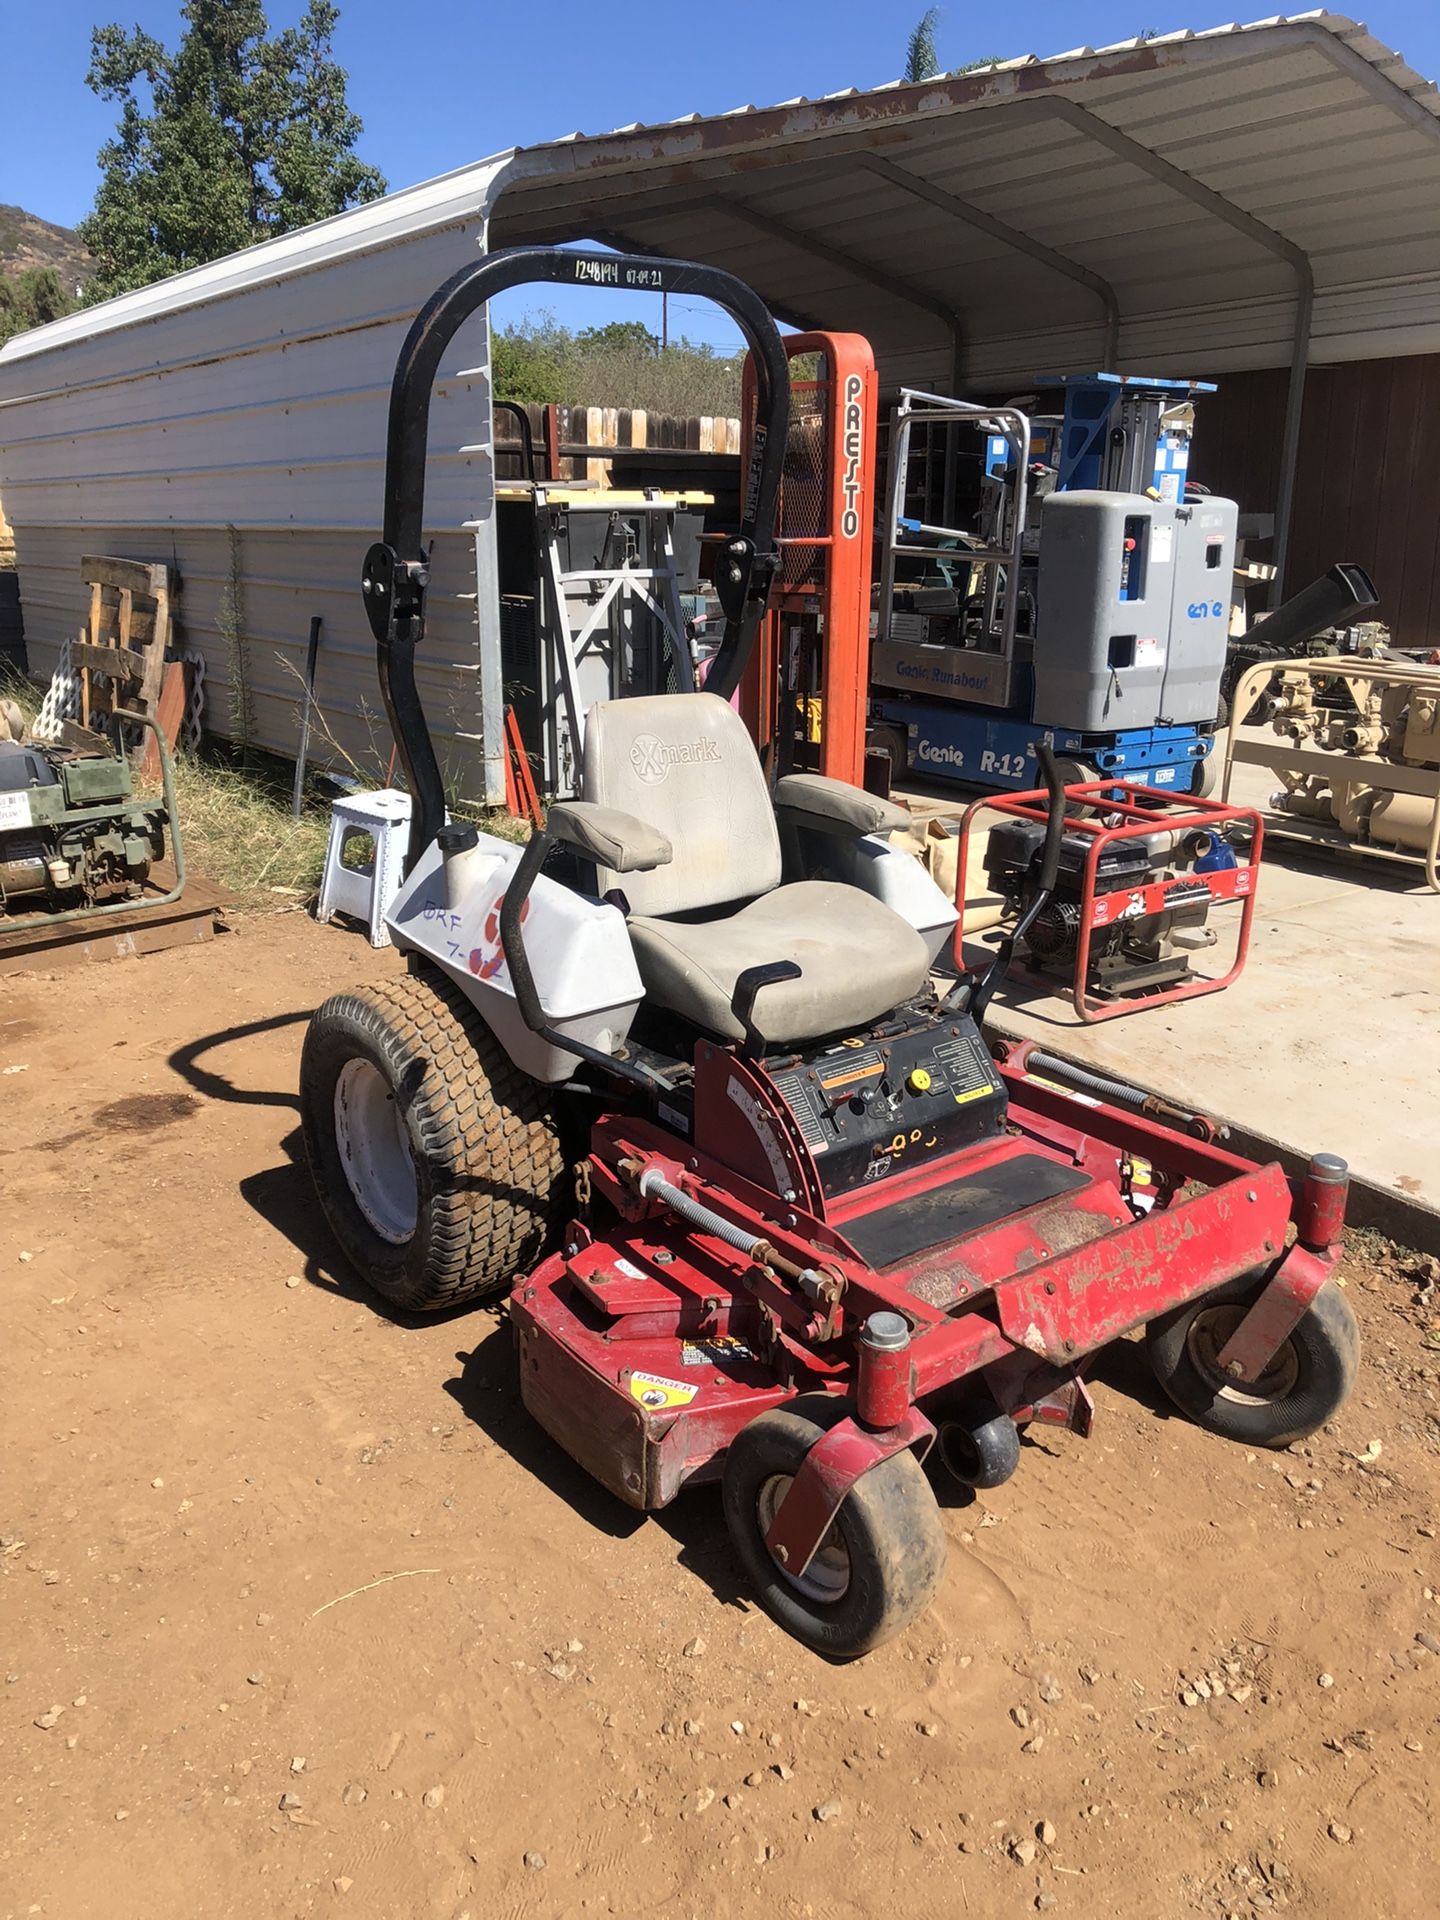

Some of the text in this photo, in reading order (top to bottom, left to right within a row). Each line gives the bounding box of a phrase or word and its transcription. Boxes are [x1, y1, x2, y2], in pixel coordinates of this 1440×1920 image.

[575, 260, 619, 283] 1248194
[843, 375, 863, 537] PRESTO
[932, 667, 989, 690] Runabout
[918, 739, 964, 768] Genie
[980, 750, 1026, 778] R-12
[636, 1373, 693, 1392] DANGER
